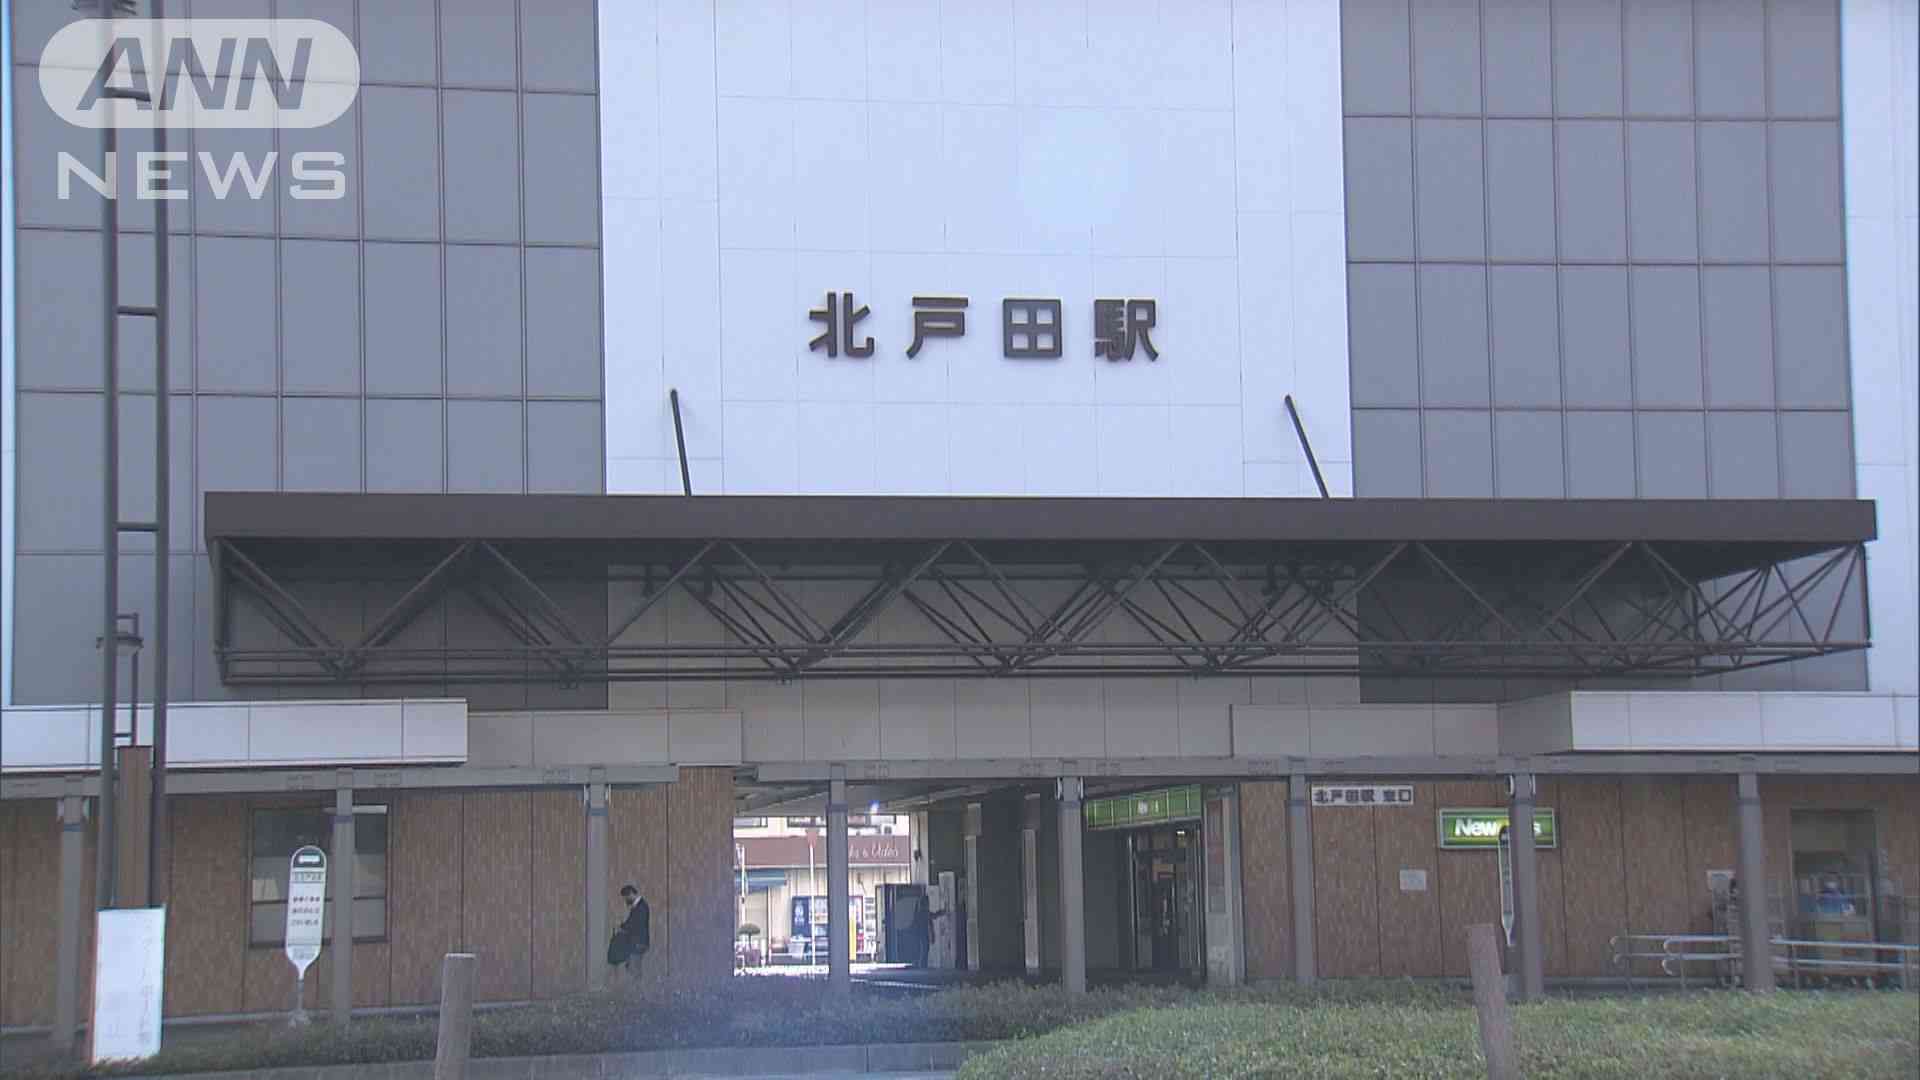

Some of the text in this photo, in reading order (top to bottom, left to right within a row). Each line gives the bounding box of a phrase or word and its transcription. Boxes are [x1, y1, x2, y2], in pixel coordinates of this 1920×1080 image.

[809, 292, 1159, 362] 北戸田駅
[1455, 818, 1541, 836] News
